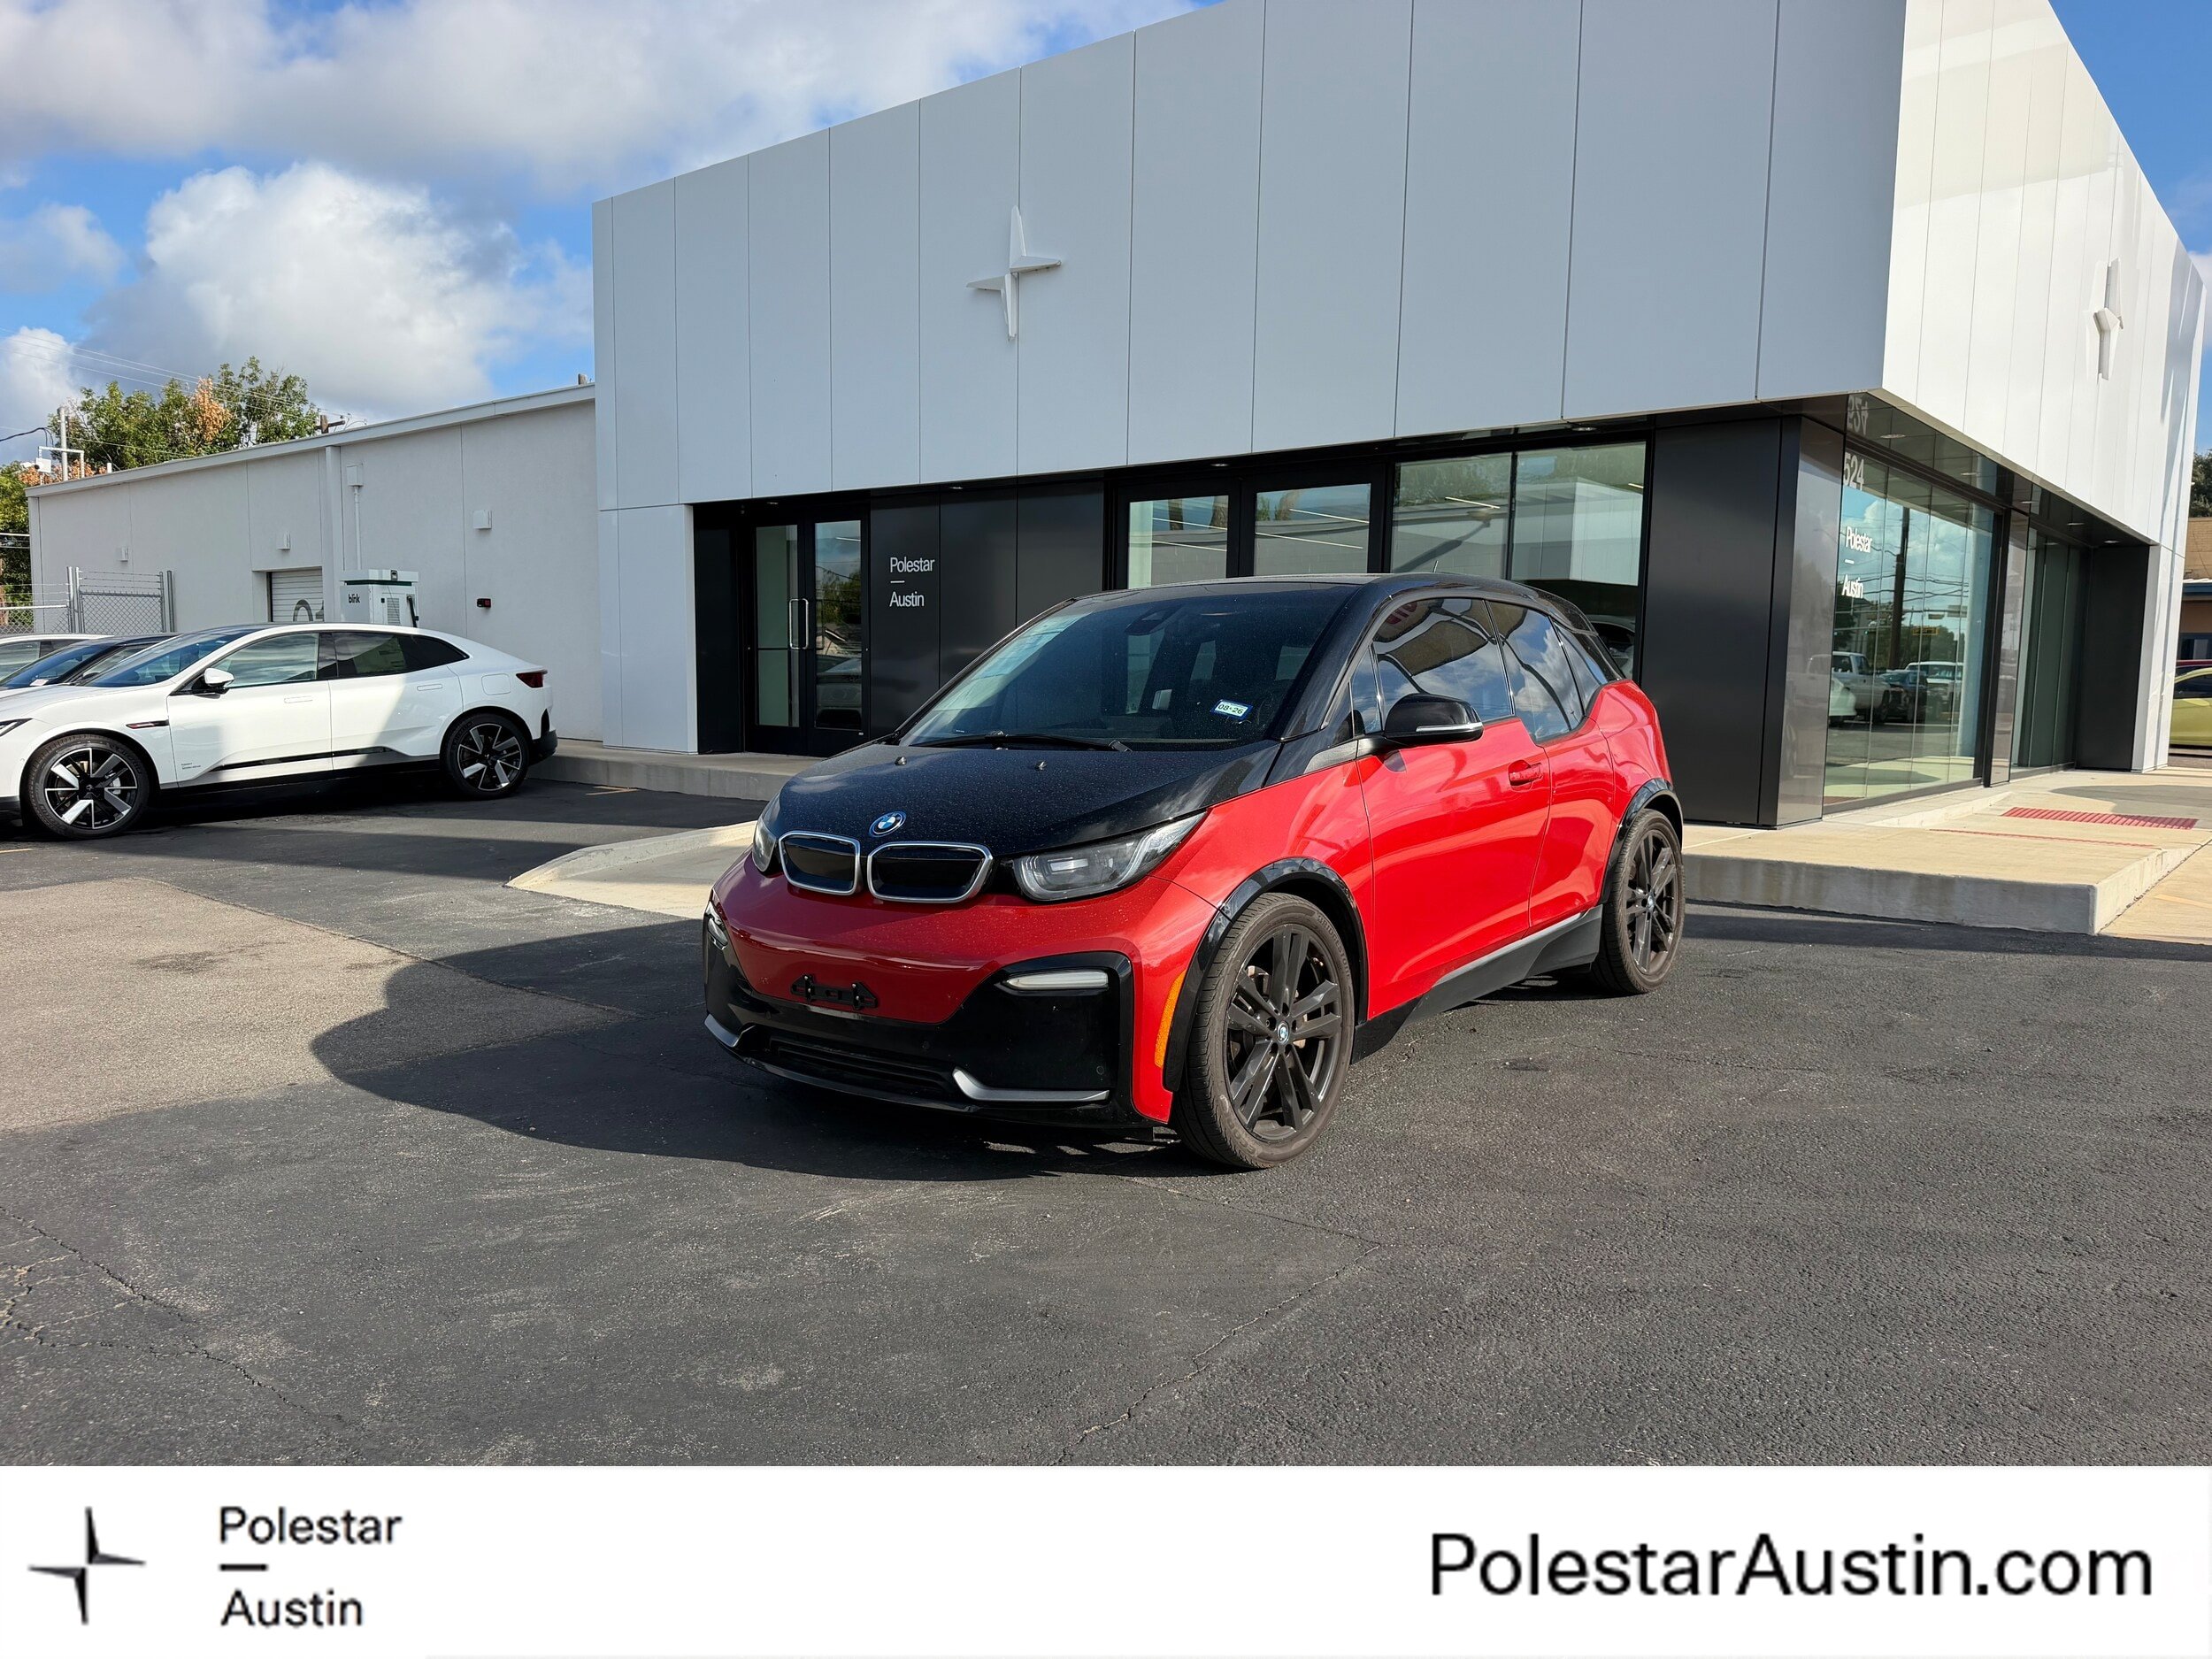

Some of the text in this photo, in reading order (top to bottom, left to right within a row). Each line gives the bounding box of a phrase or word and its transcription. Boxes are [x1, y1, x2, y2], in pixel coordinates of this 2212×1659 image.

[1843, 452, 1864, 491] 524
[1846, 526, 1873, 553] Polestar
[890, 556, 935, 573] Polestar
[889, 590, 925, 607] Austin
[1841, 573, 1864, 599] Austin
